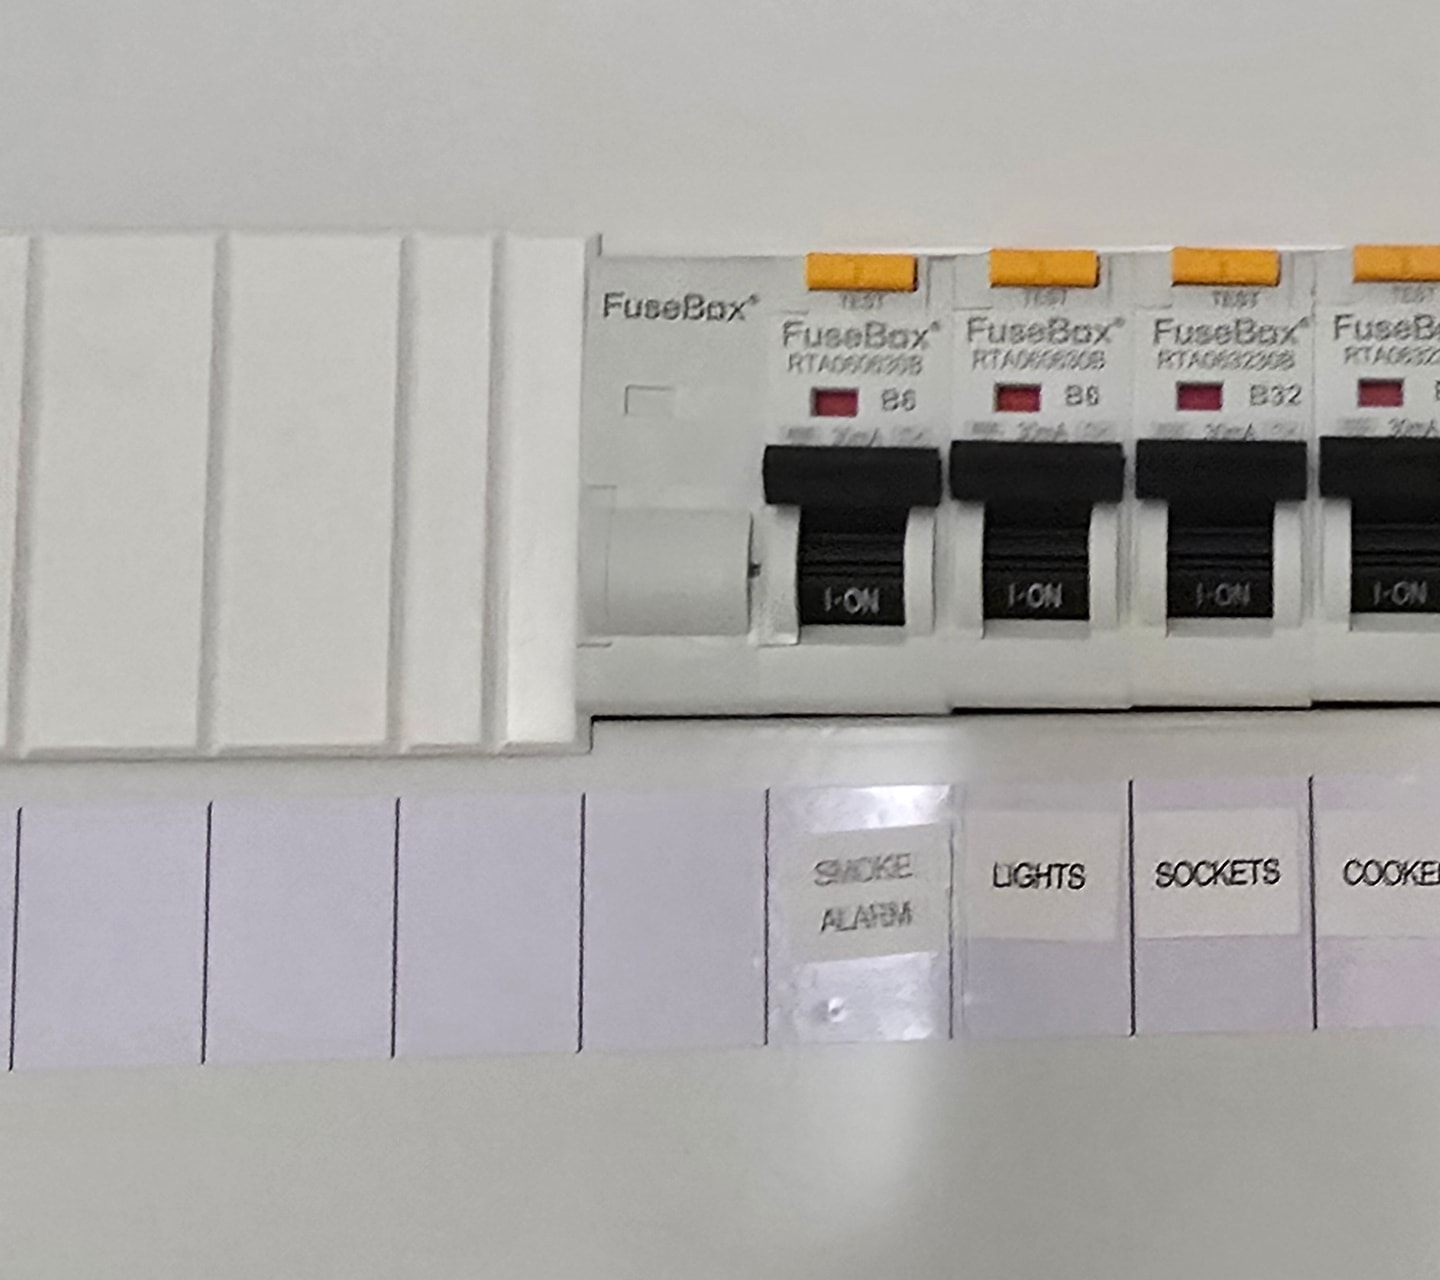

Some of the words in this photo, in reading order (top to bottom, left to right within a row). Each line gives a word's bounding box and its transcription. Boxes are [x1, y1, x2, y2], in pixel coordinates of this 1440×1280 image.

[881, 387, 917, 412] B6
[1065, 384, 1100, 407] B6
[1250, 383, 1302, 407] B32
[813, 852, 914, 887] SMOKE
[991, 861, 1087, 891] LIGHTS
[1154, 857, 1282, 888] SOCKETS
[819, 900, 914, 934] ALARM
